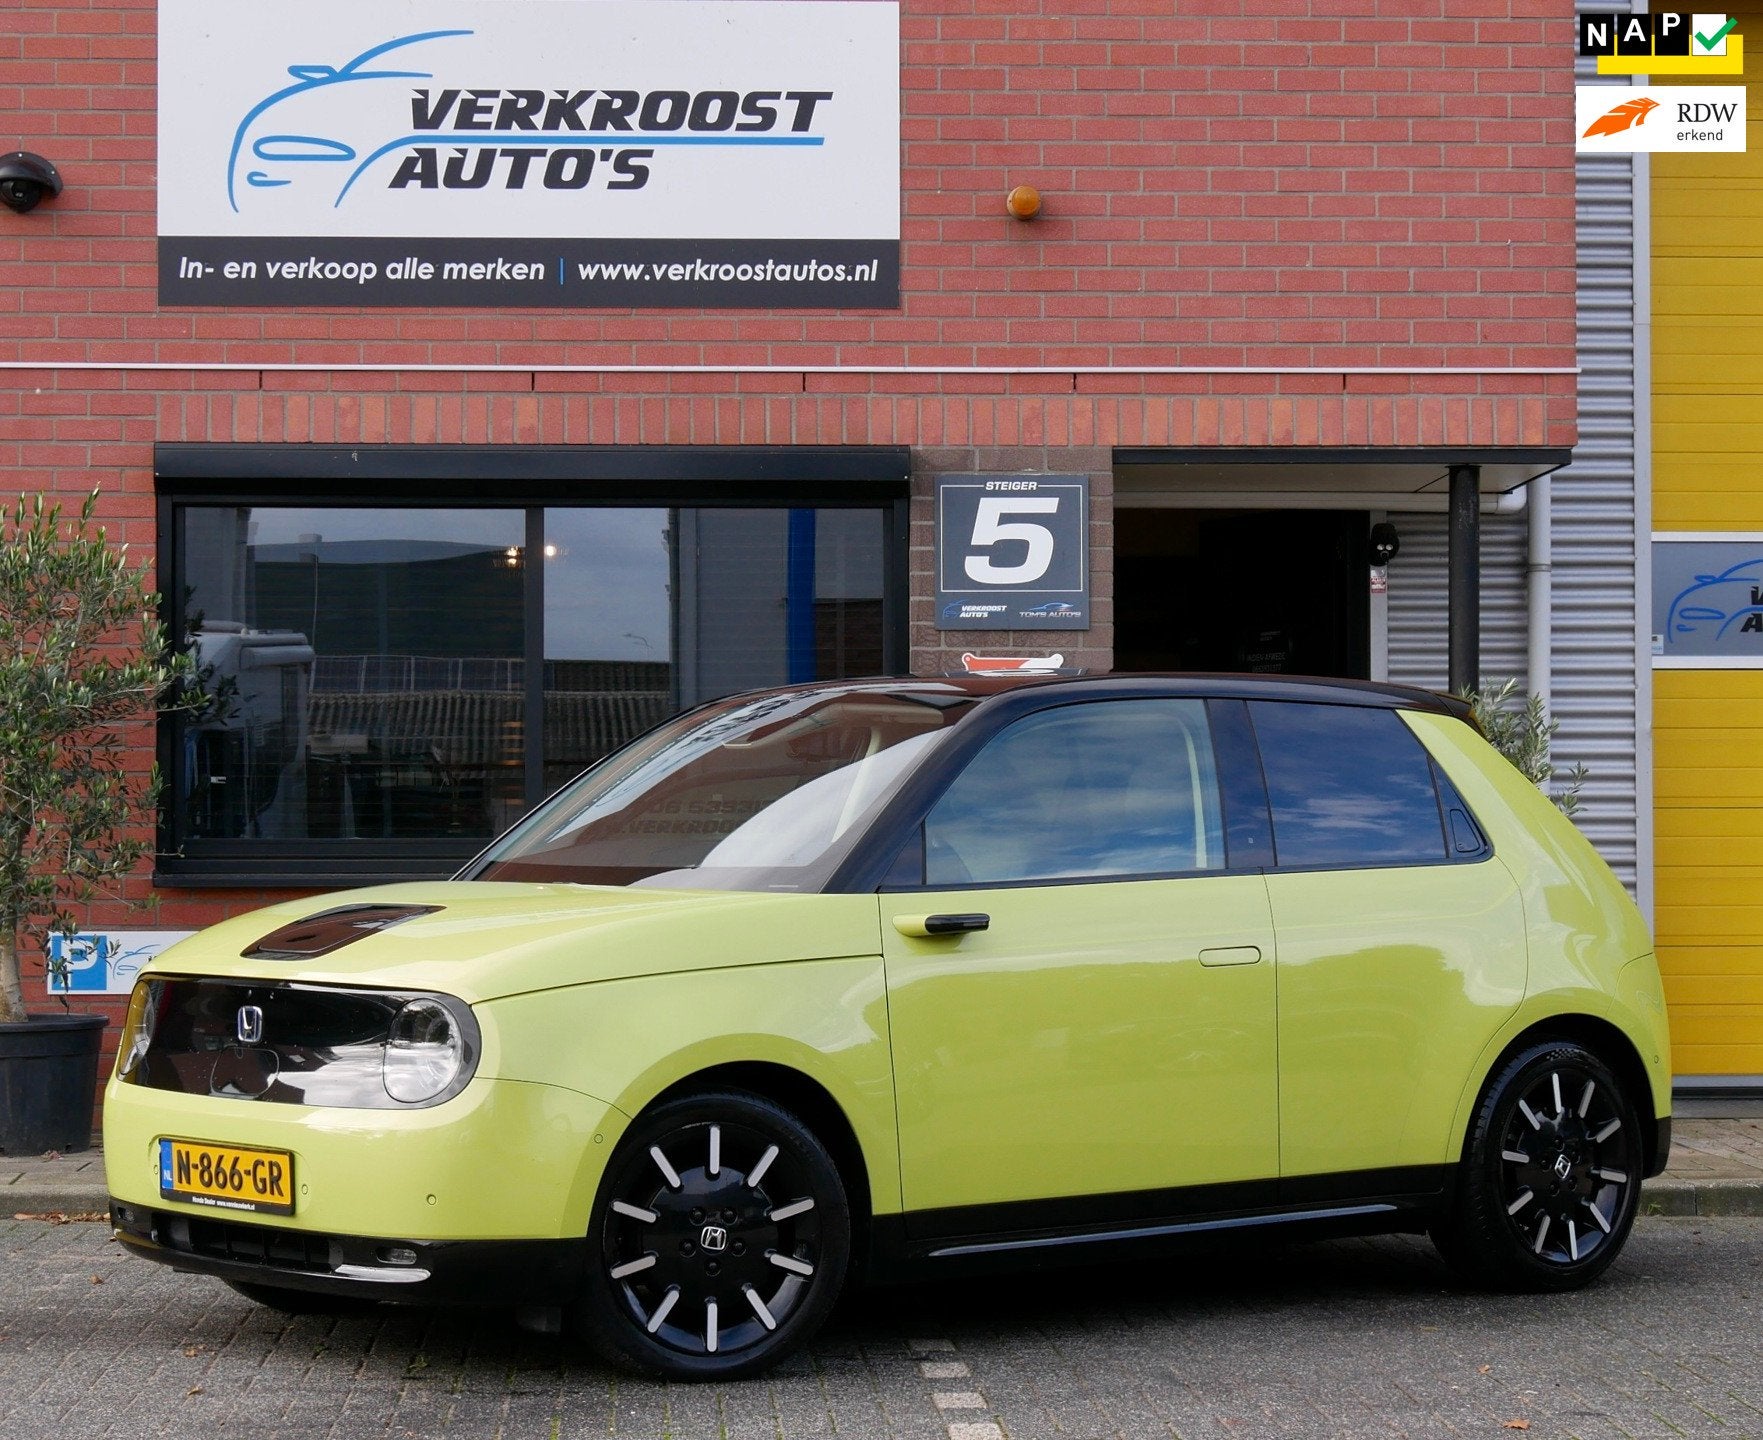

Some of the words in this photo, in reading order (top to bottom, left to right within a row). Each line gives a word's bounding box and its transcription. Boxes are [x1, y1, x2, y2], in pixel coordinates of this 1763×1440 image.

[411, 89, 833, 132] VERKROOST
[388, 149, 653, 190] AUTO'S
[179, 257, 214, 279] In-
[222, 260, 257, 280] en
[264, 257, 377, 286] verkoop
[386, 257, 435, 281] alle
[443, 257, 545, 281] merken
[578, 259, 878, 283] www.verkroostautos.nl
[985, 481, 1038, 491] STEIGER
[964, 497, 1060, 585] 5
[61, 940, 98, 988] P
[163, 1170, 172, 1181] NL
[176, 1149, 284, 1197] N-866-GR
